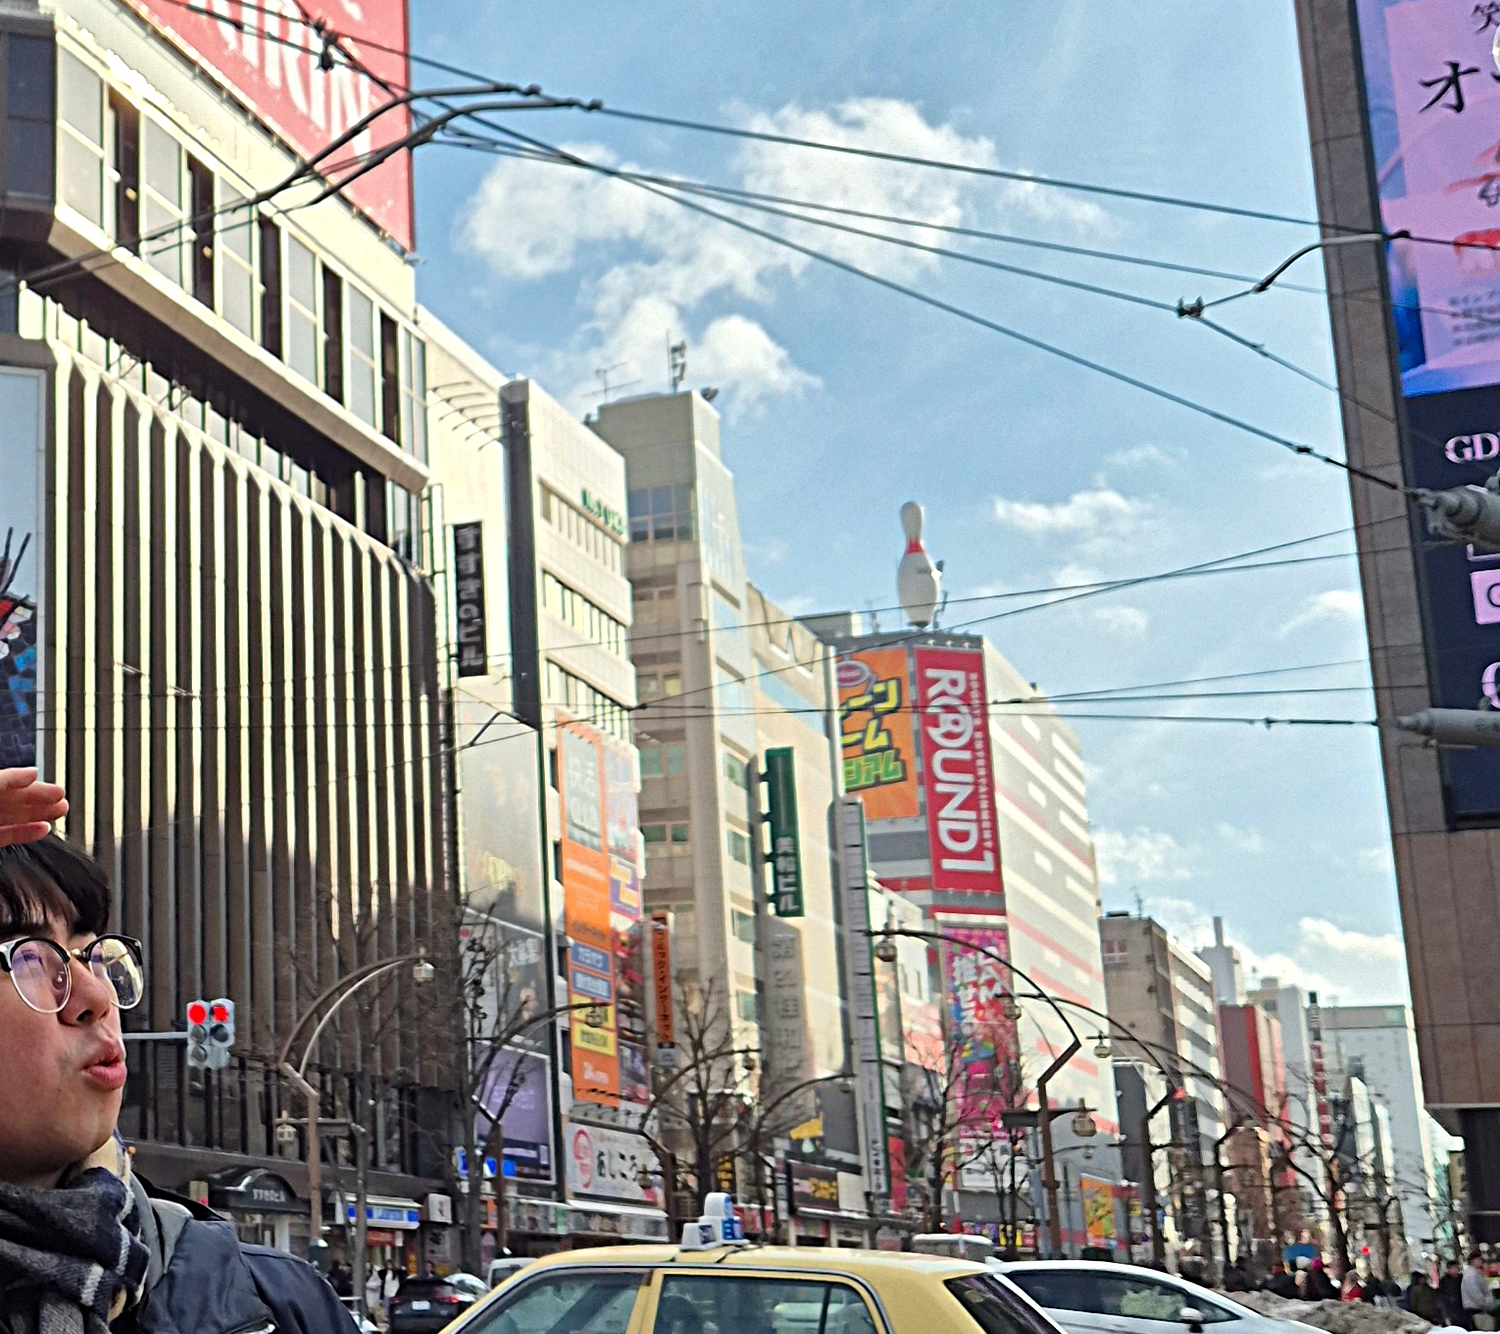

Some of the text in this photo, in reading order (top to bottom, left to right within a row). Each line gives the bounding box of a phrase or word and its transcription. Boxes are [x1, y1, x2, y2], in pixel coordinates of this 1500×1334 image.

[456, 525, 486, 669] すすきのビル
[925, 668, 994, 873] ROUND1
